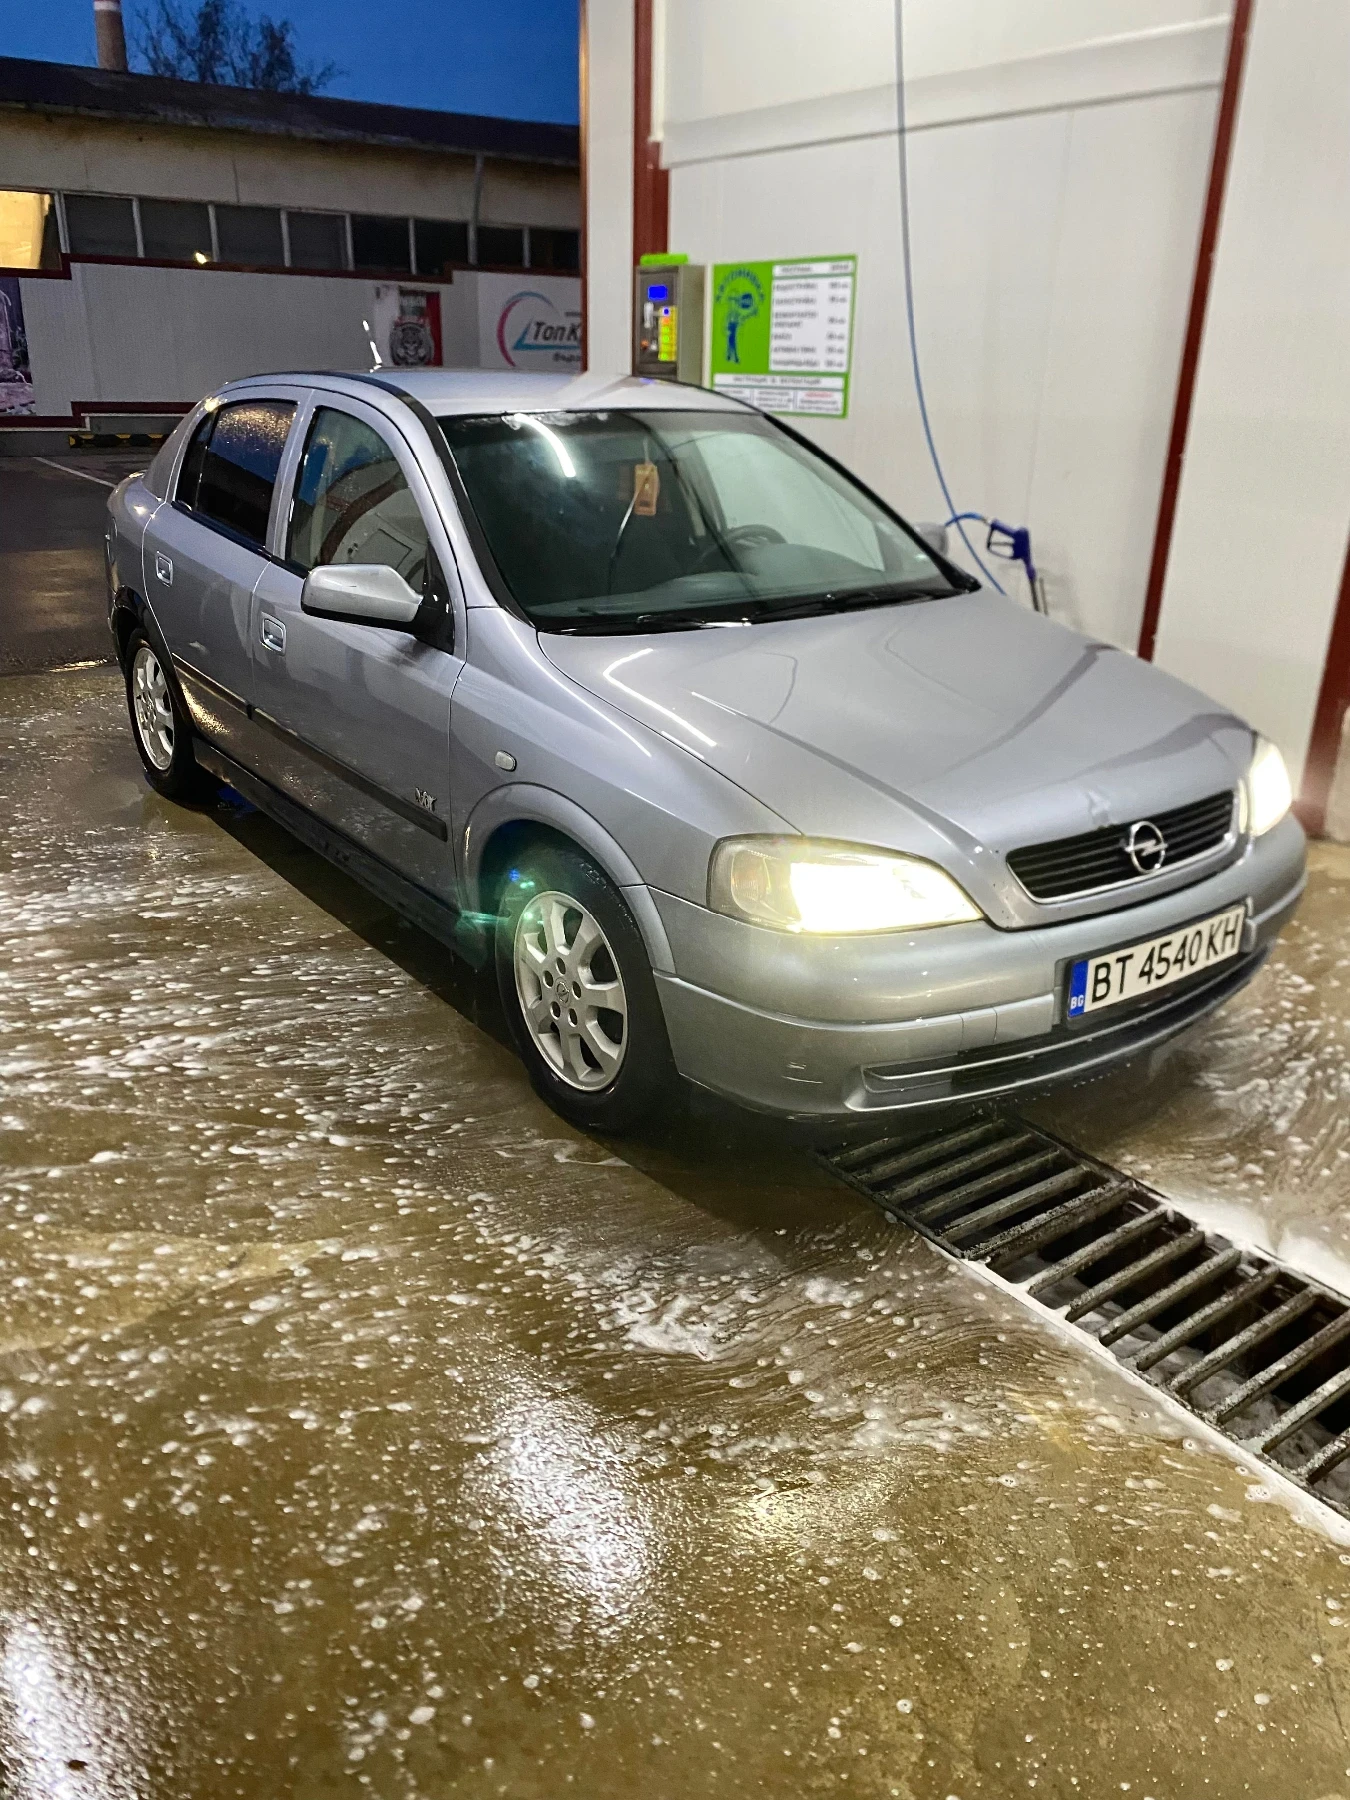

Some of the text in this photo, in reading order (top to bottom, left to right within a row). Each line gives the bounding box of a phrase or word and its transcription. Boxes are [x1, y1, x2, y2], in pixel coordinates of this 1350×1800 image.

[1091, 913, 1241, 1004] BT 4540 KH
[1069, 994, 1084, 1010] BG
